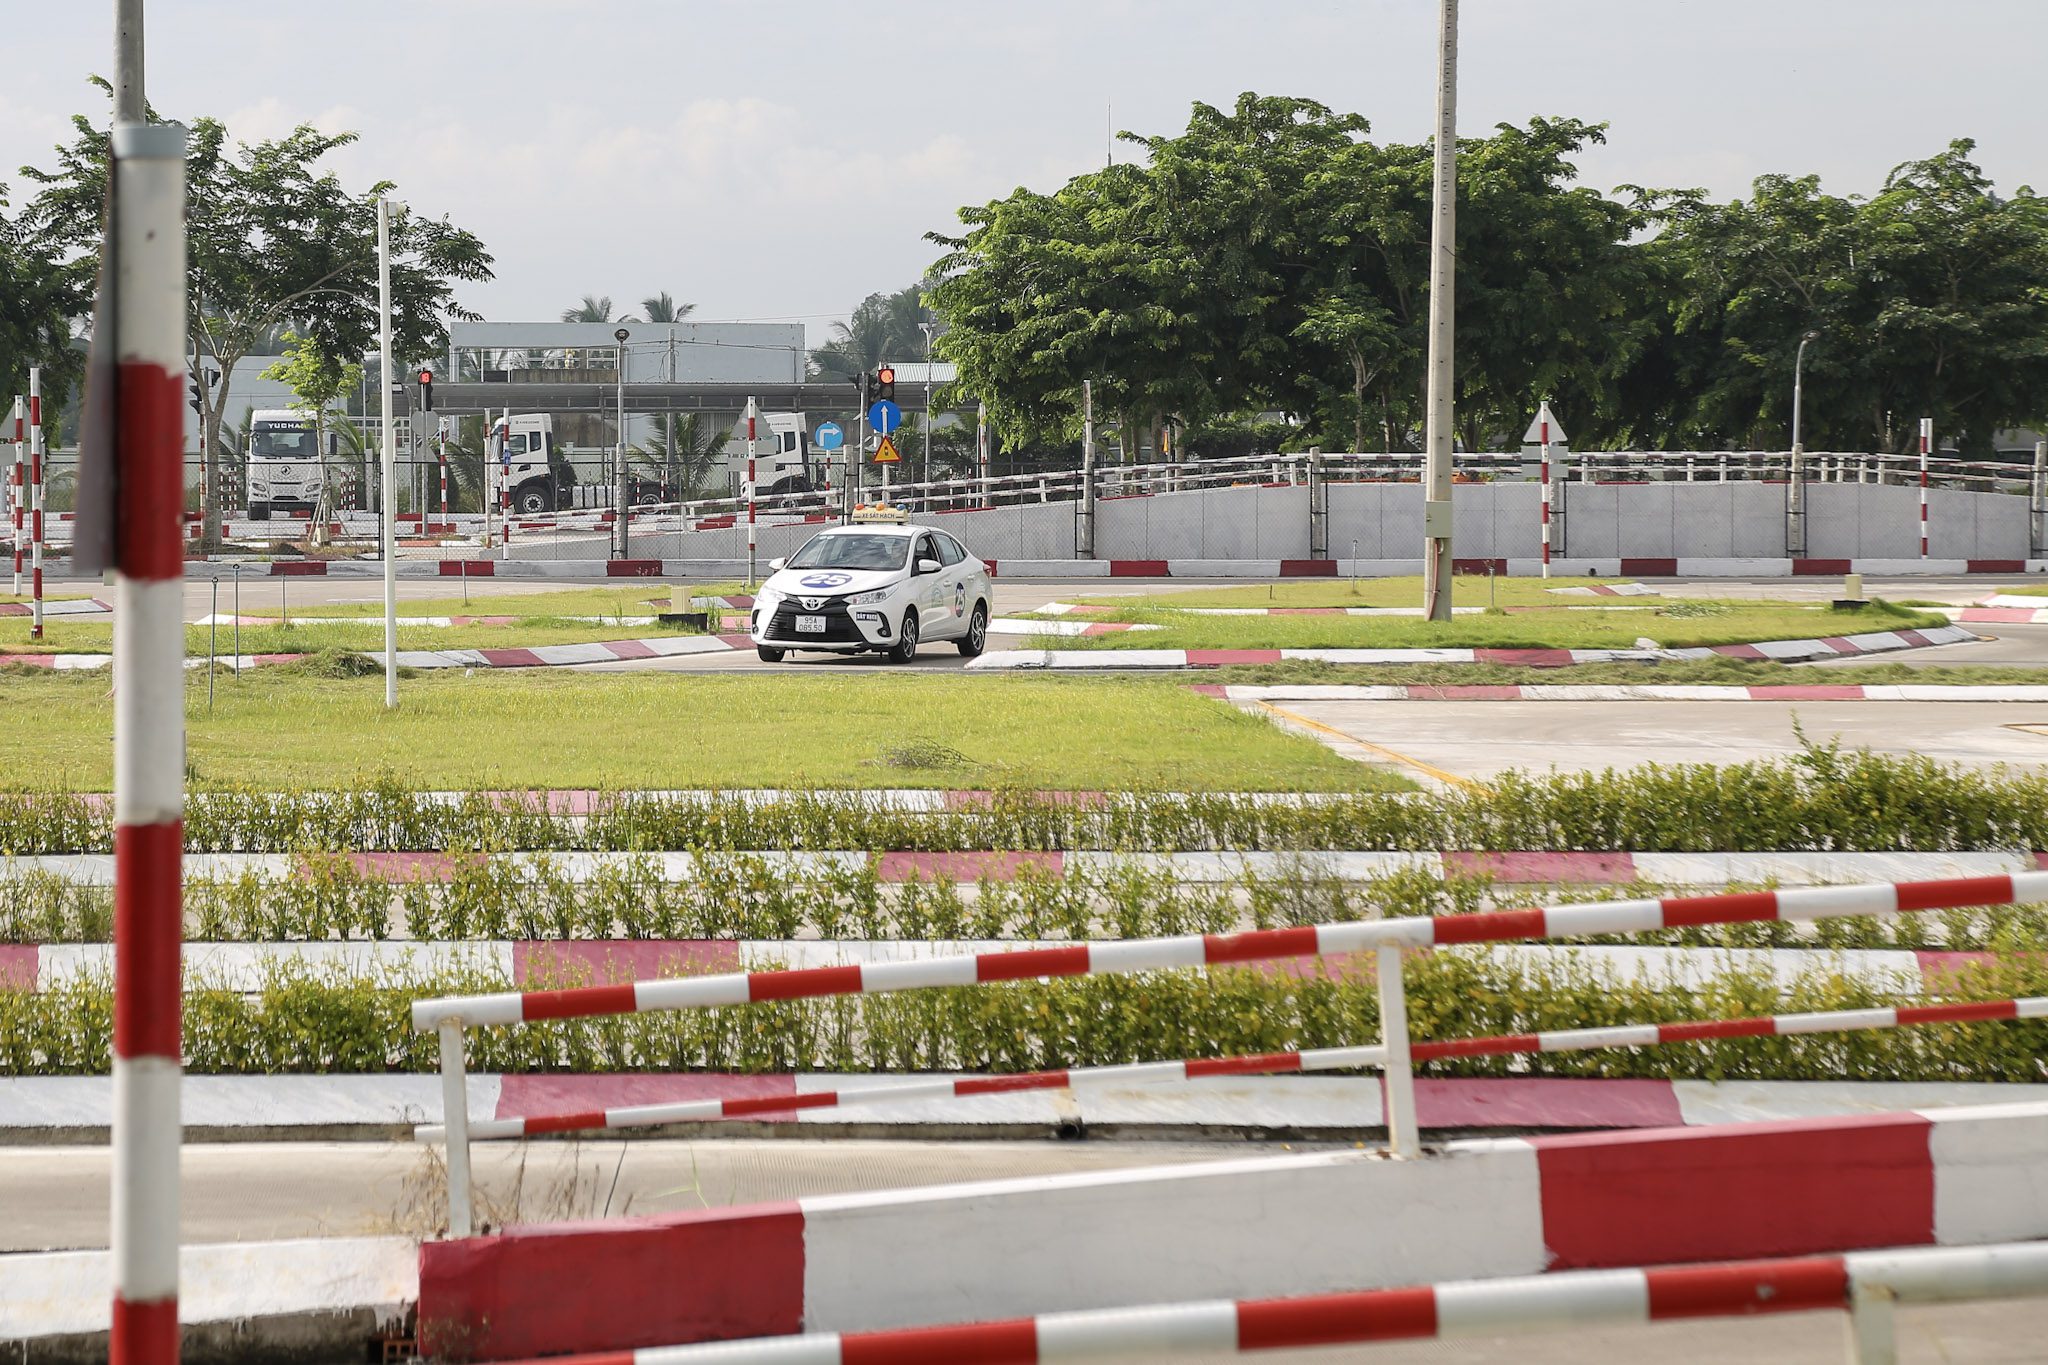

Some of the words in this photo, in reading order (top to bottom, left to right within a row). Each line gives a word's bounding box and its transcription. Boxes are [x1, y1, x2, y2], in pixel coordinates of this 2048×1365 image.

[801, 574, 851, 585] 25
[955, 589, 965, 611] 25
[804, 616, 818, 624] 95A
